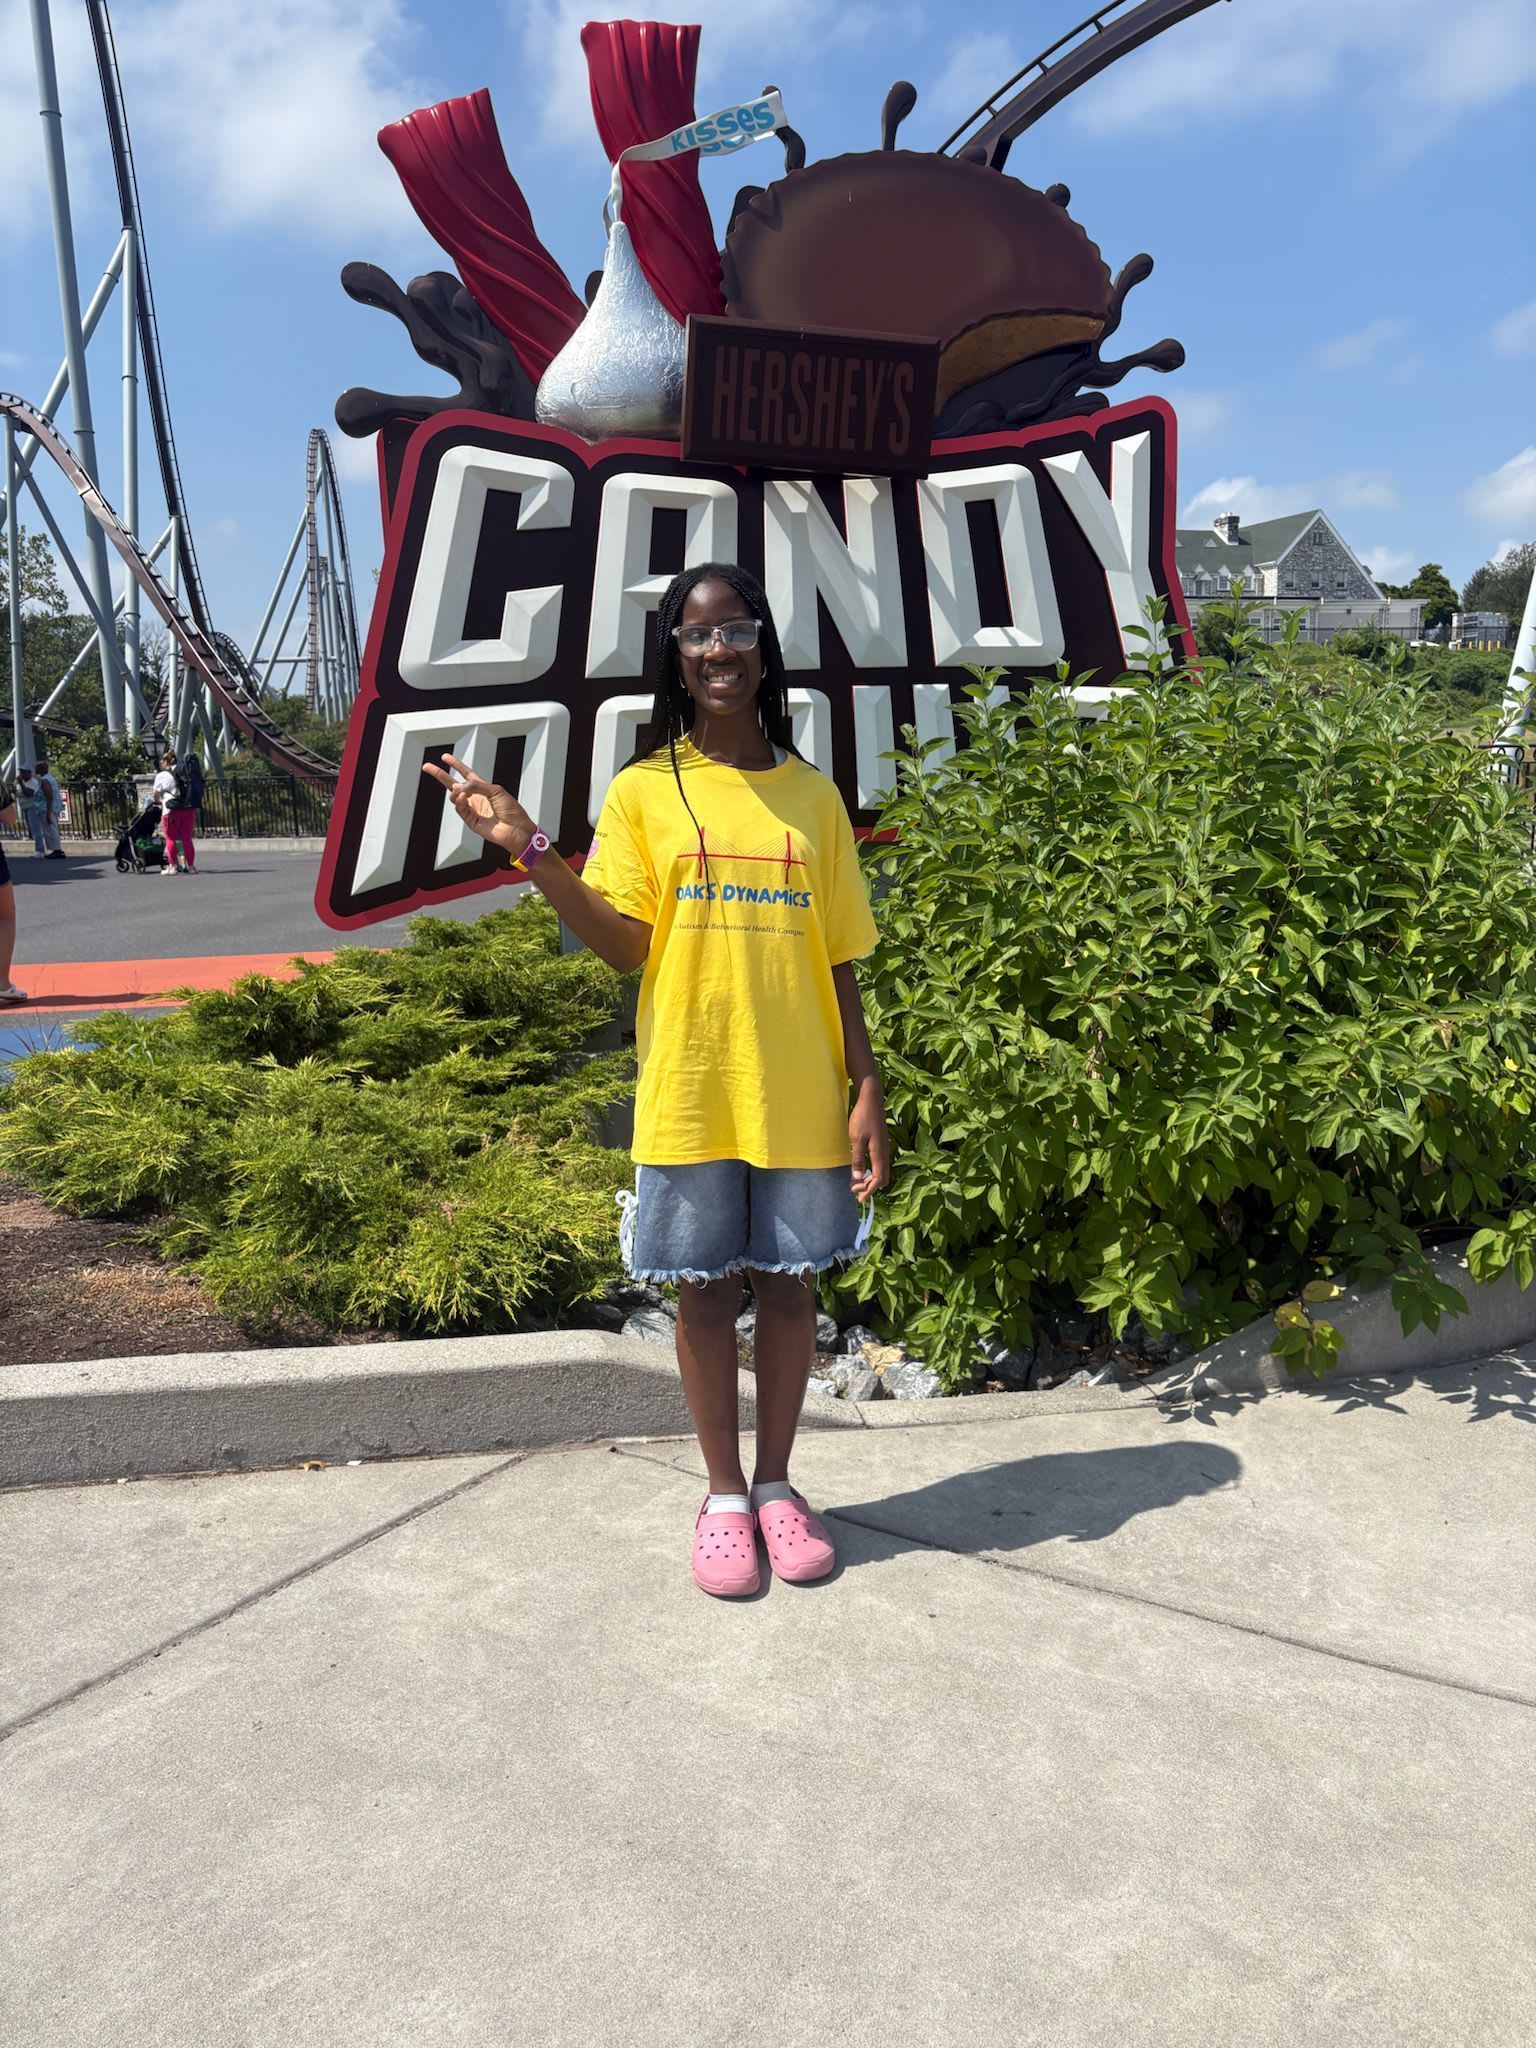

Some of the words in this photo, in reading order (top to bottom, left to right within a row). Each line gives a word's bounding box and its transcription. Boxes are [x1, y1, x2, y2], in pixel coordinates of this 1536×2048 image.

[711, 345, 915, 456] HERSHEY'S
[398, 430, 1175, 690] CANDY
[710, 923, 751, 932] Behavioral
[751, 924, 776, 934] Health
